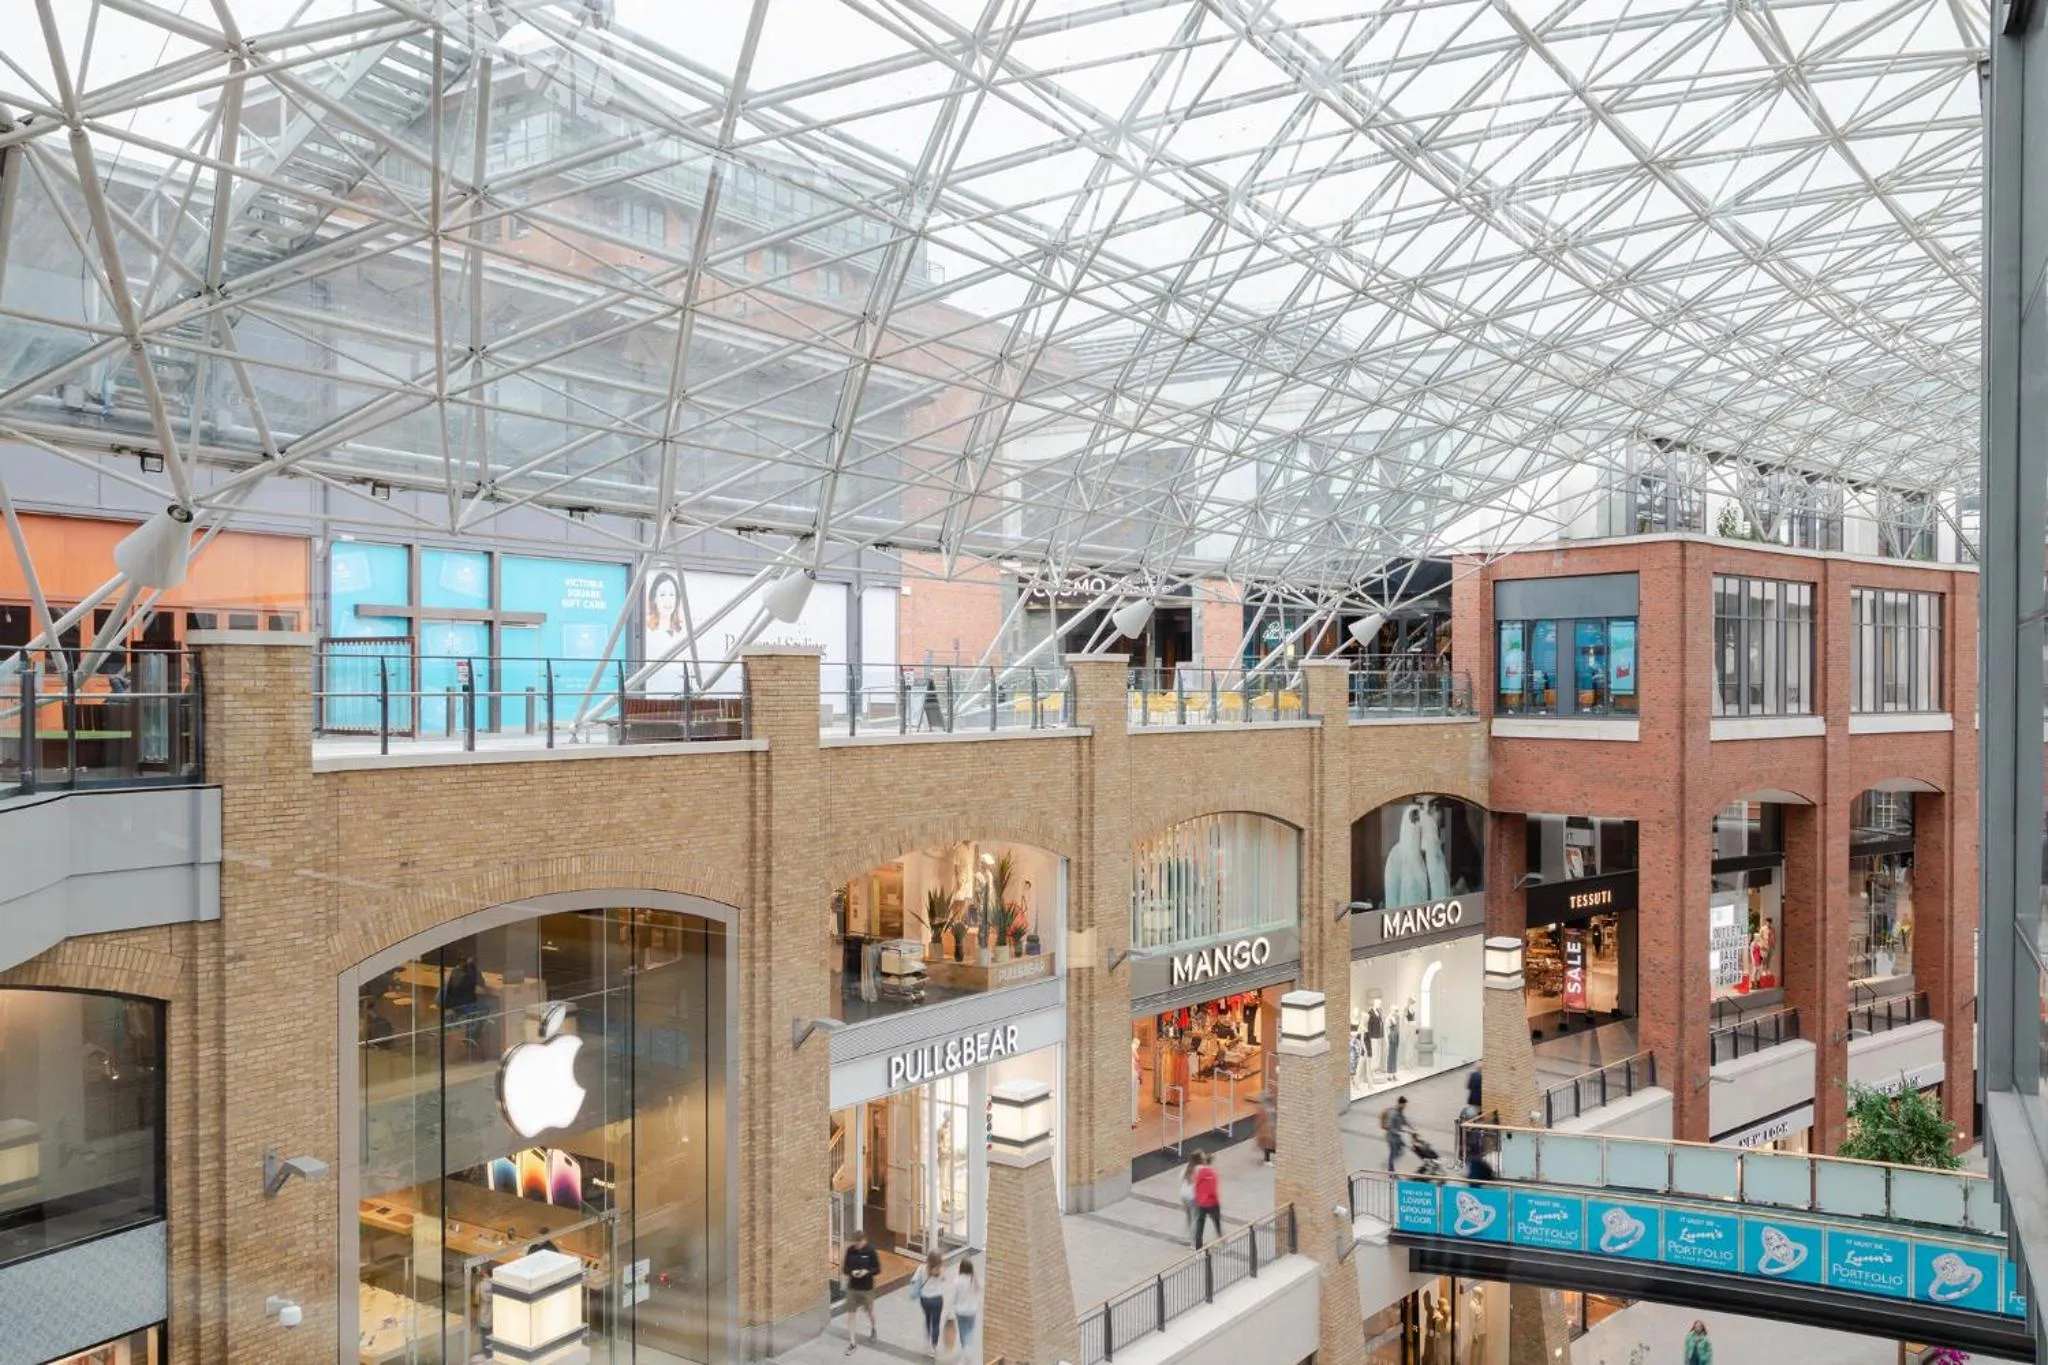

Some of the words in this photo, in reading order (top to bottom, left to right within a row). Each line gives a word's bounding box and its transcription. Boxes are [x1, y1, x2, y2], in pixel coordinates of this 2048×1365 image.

[1570, 890, 1611, 909] TESSUTI
[1382, 900, 1462, 939] MANGO
[1171, 937, 1270, 986] MANGO
[1567, 941, 1582, 993] SALE
[888, 1024, 1019, 1087] PULL&BEAR
[1763, 1121, 1789, 1140] LOOK
[1400, 1205, 1436, 1216] GROUND
[1403, 1195, 1432, 1206] LOWER
[1404, 1215, 1432, 1224] FLOOR
[1518, 1221, 1578, 1241] PORTFOLIO
[1668, 1240, 1734, 1261] PORTFOLIO
[1832, 1263, 1903, 1286] PORTFOLIO
